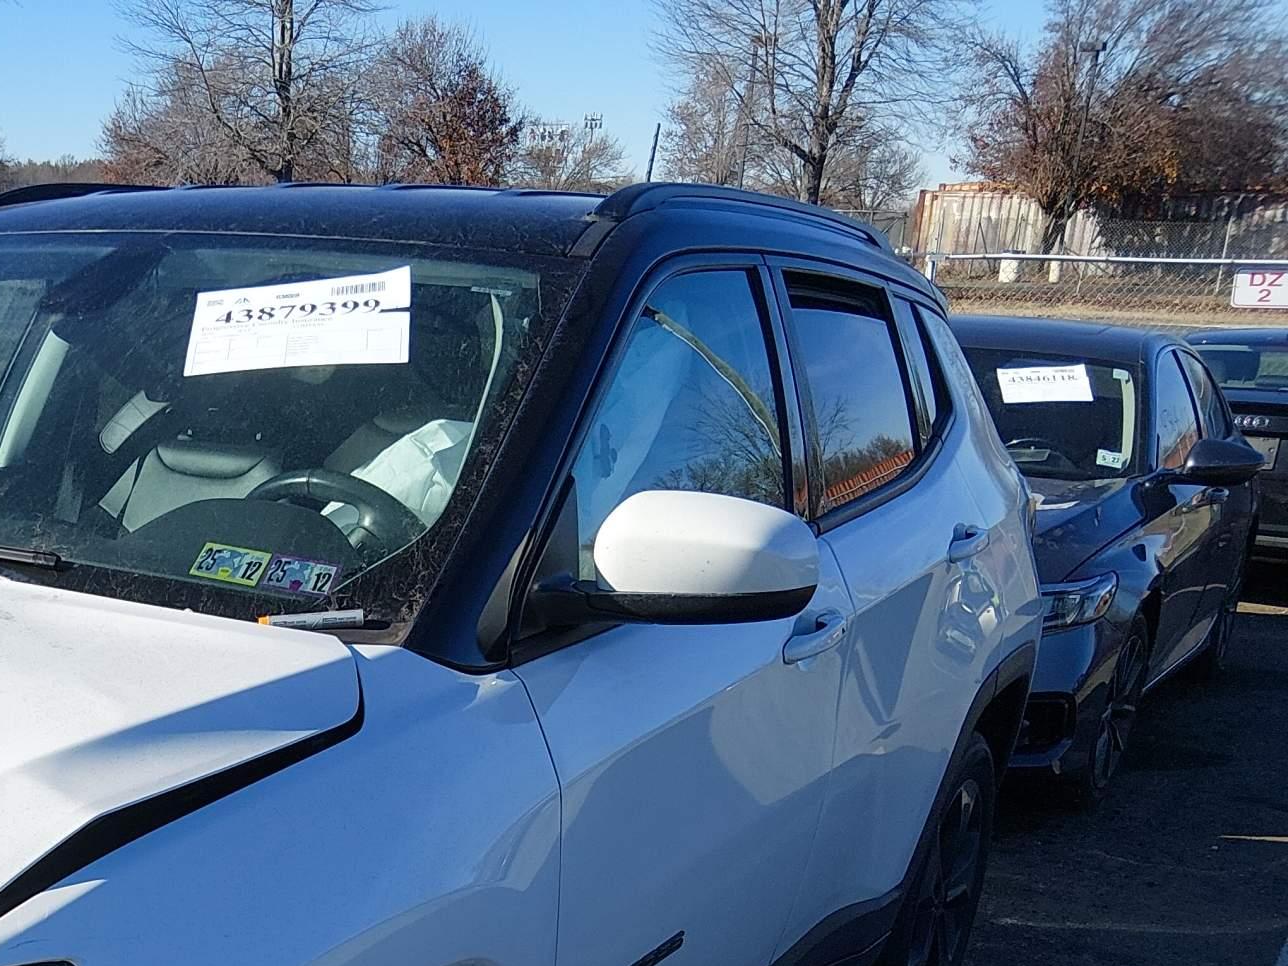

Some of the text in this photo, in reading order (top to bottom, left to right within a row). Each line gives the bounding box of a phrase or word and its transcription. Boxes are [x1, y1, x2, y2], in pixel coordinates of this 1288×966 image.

[1249, 272, 1285, 287] DZ
[1257, 288, 1271, 303] 2
[215, 298, 381, 324] 43879399
[197, 547, 263, 581] 25 12
[267, 559, 333, 592] 25 12
